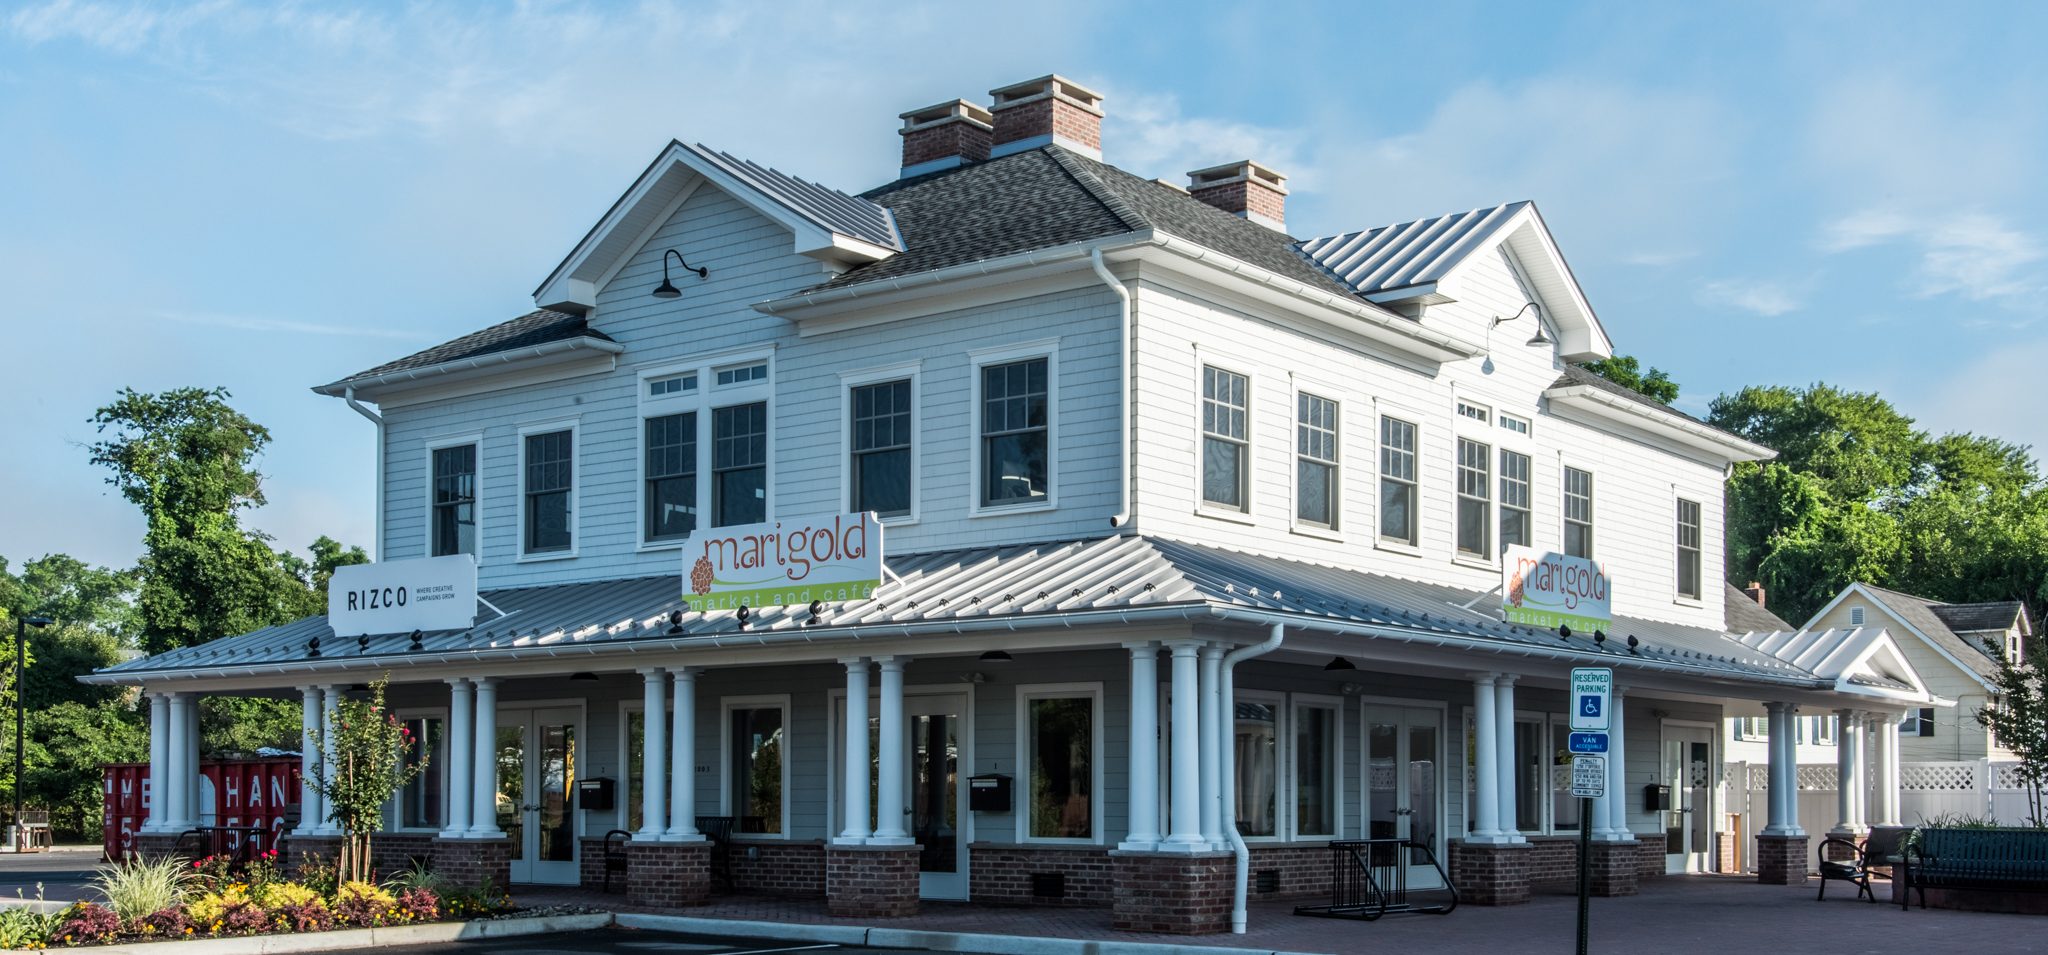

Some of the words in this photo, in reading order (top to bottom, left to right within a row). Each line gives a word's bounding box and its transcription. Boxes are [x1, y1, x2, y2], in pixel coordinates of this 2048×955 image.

[704, 512, 866, 581] marigold
[432, 585, 453, 593] CREATIVE
[1517, 554, 1605, 610] marigold
[347, 586, 407, 611] RIZCO
[416, 594, 441, 602] CAMPAIGNS
[690, 594, 761, 611] market
[774, 590, 811, 606] and
[823, 583, 872, 601] café
[1508, 611, 1552, 627] market
[1559, 617, 1578, 630] and
[1575, 674, 1609, 683] RESERVED
[1577, 684, 1607, 693] PARKING
